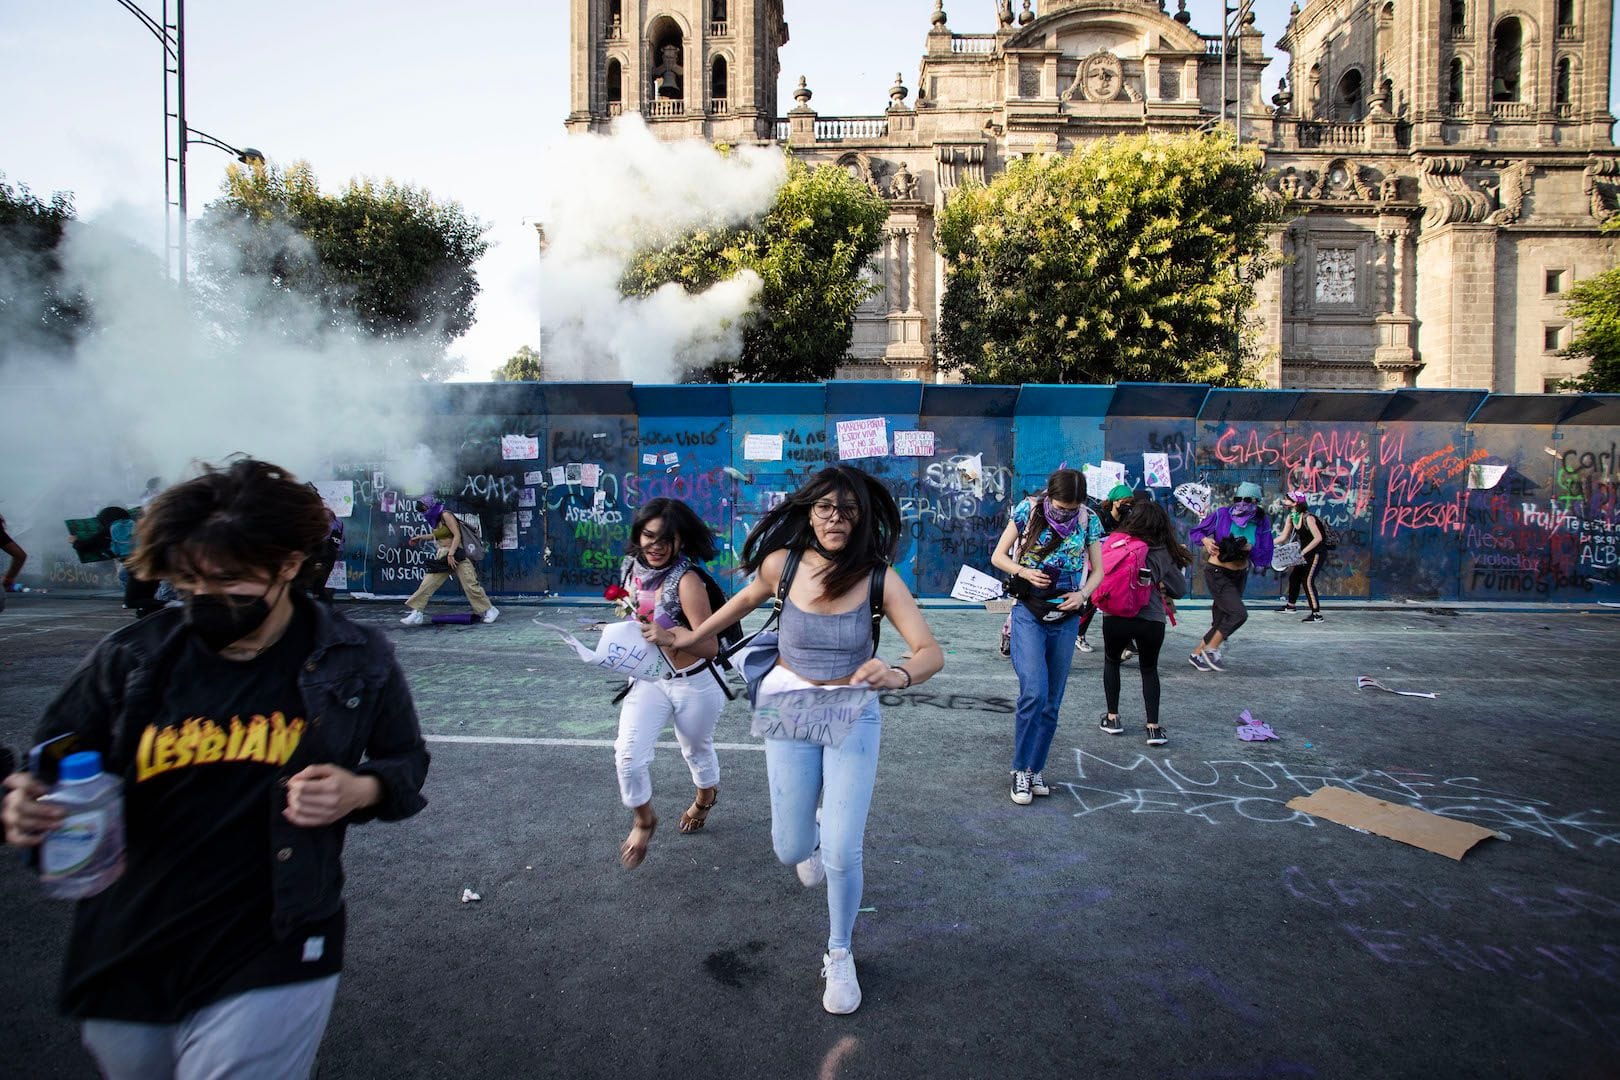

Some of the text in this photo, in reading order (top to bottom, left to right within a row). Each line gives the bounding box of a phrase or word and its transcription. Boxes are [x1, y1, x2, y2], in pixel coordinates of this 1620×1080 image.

[842, 431, 860, 442] ESTOY
[1562, 442, 1620, 474] Carl
[461, 474, 518, 503] ACAB
[395, 512, 410, 523] ME
[387, 523, 396, 536] A
[376, 543, 402, 564] SOY
[382, 566, 428, 581] NO SEÑO
[878, 693, 1015, 714] ORES
[136, 711, 306, 783] LESBIAN
